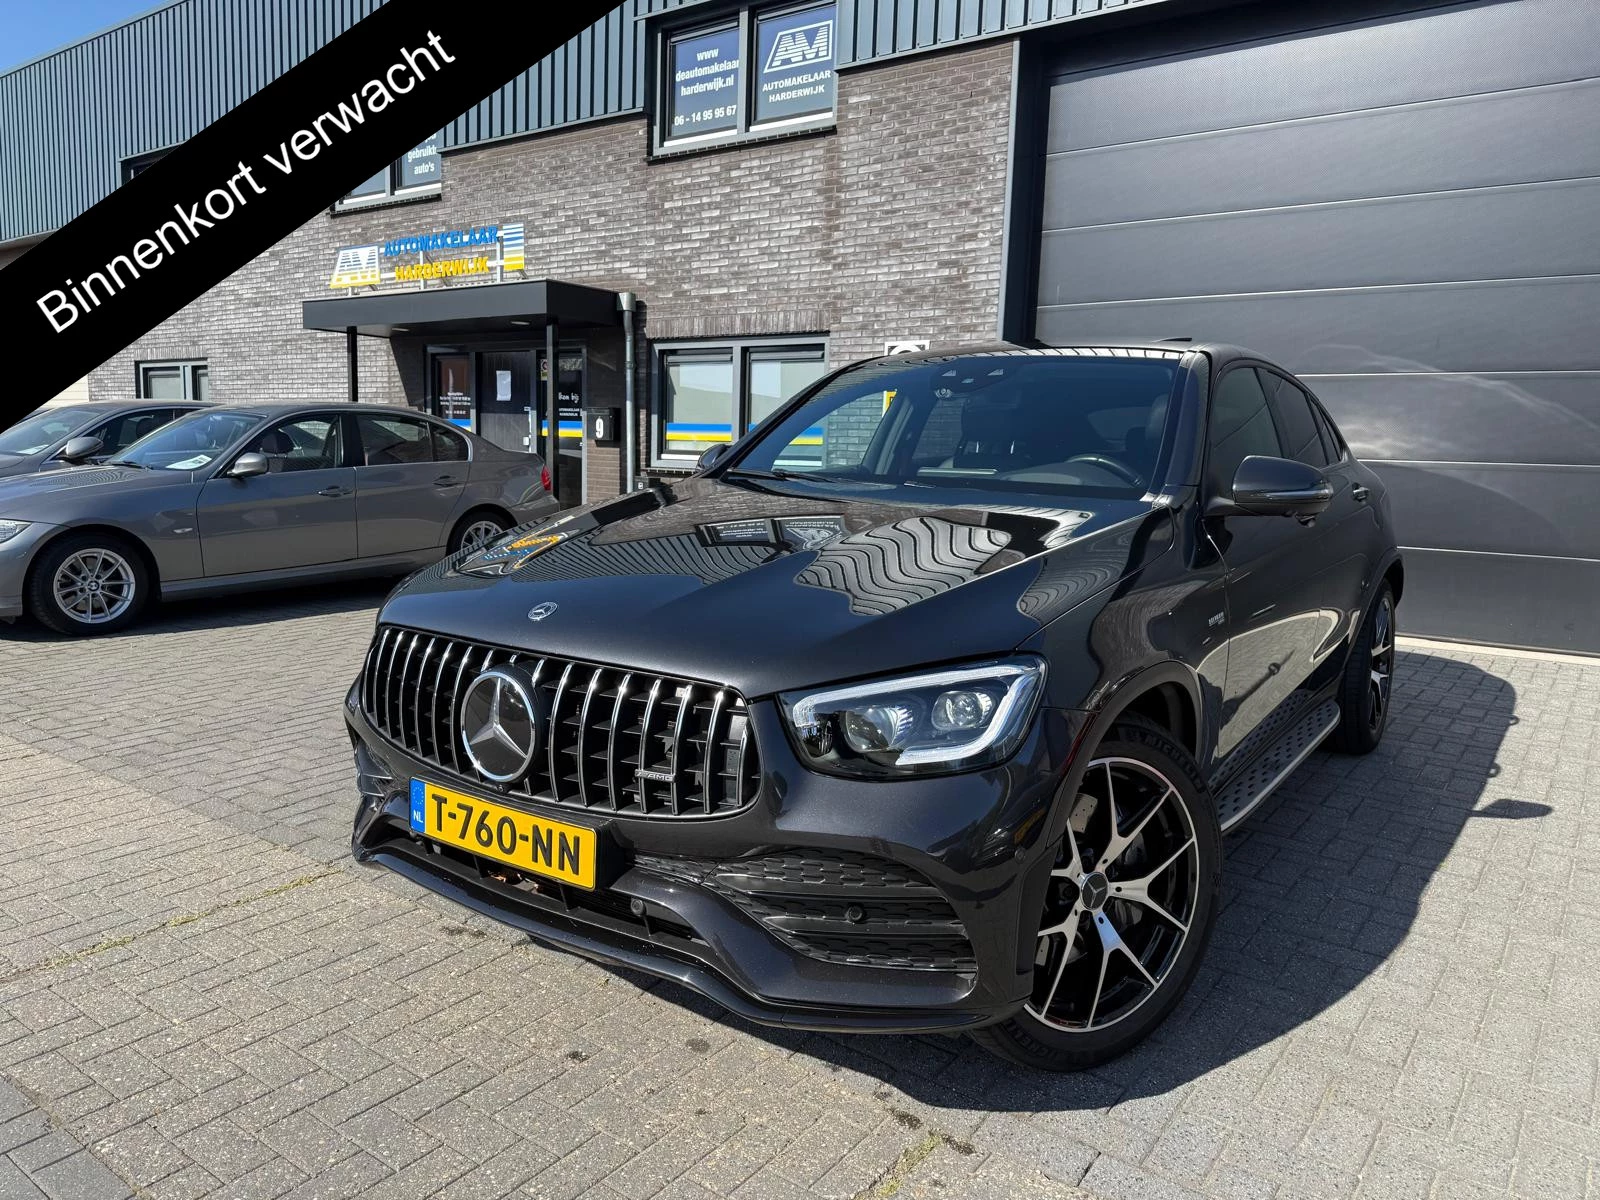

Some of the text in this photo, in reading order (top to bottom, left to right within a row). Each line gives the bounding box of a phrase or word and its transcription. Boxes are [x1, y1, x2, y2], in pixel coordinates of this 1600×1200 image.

[697, 48, 719, 61] www
[676, 59, 740, 82] deautomakelaar
[762, 70, 832, 92] AUTOMAKELAAR
[681, 75, 735, 97] harderwijk.nl
[769, 84, 825, 103] HARDERWIJK
[674, 114, 684, 126] 06
[691, 111, 701, 123] 14
[703, 109, 713, 121] 95
[714, 107, 725, 119] 95
[726, 105, 737, 117] 67
[414, 161, 435, 175] auto's
[384, 226, 498, 257] AUTOMAKELAAR
[395, 256, 489, 281] HARDERWIJK
[595, 417, 604, 438] 9
[413, 810, 424, 823] NL
[431, 793, 580, 875] T-760-NN
